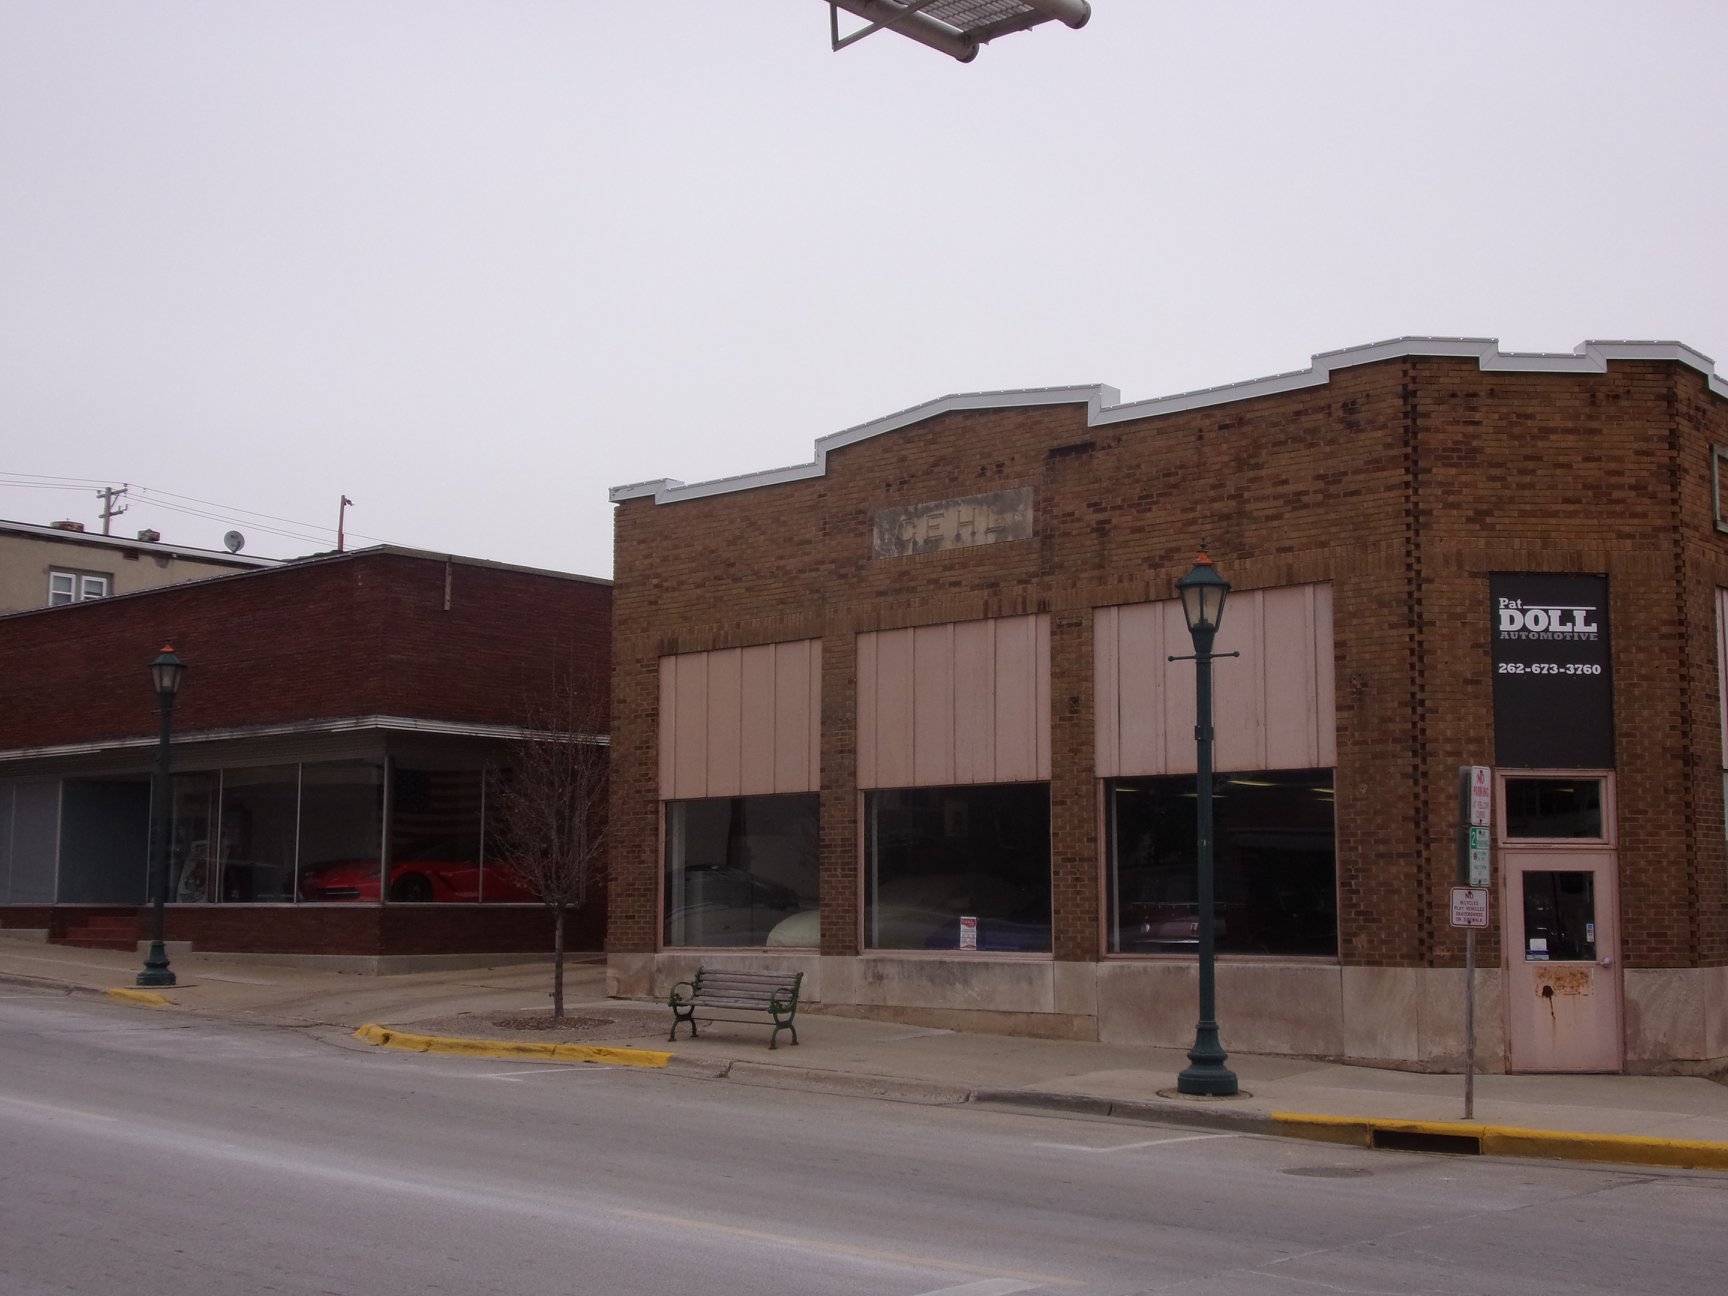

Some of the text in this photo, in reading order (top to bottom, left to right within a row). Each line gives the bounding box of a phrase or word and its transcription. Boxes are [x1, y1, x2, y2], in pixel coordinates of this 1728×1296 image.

[1499, 598, 1522, 609] Pat
[1499, 609, 1598, 632] DOLL
[1500, 632, 1599, 641] AUTOMOTIVE
[1498, 663, 1601, 675] 262-673-3760
[1477, 772, 1485, 785] NO
[1471, 831, 1476, 846] 2
[1464, 892, 1474, 900] NO
